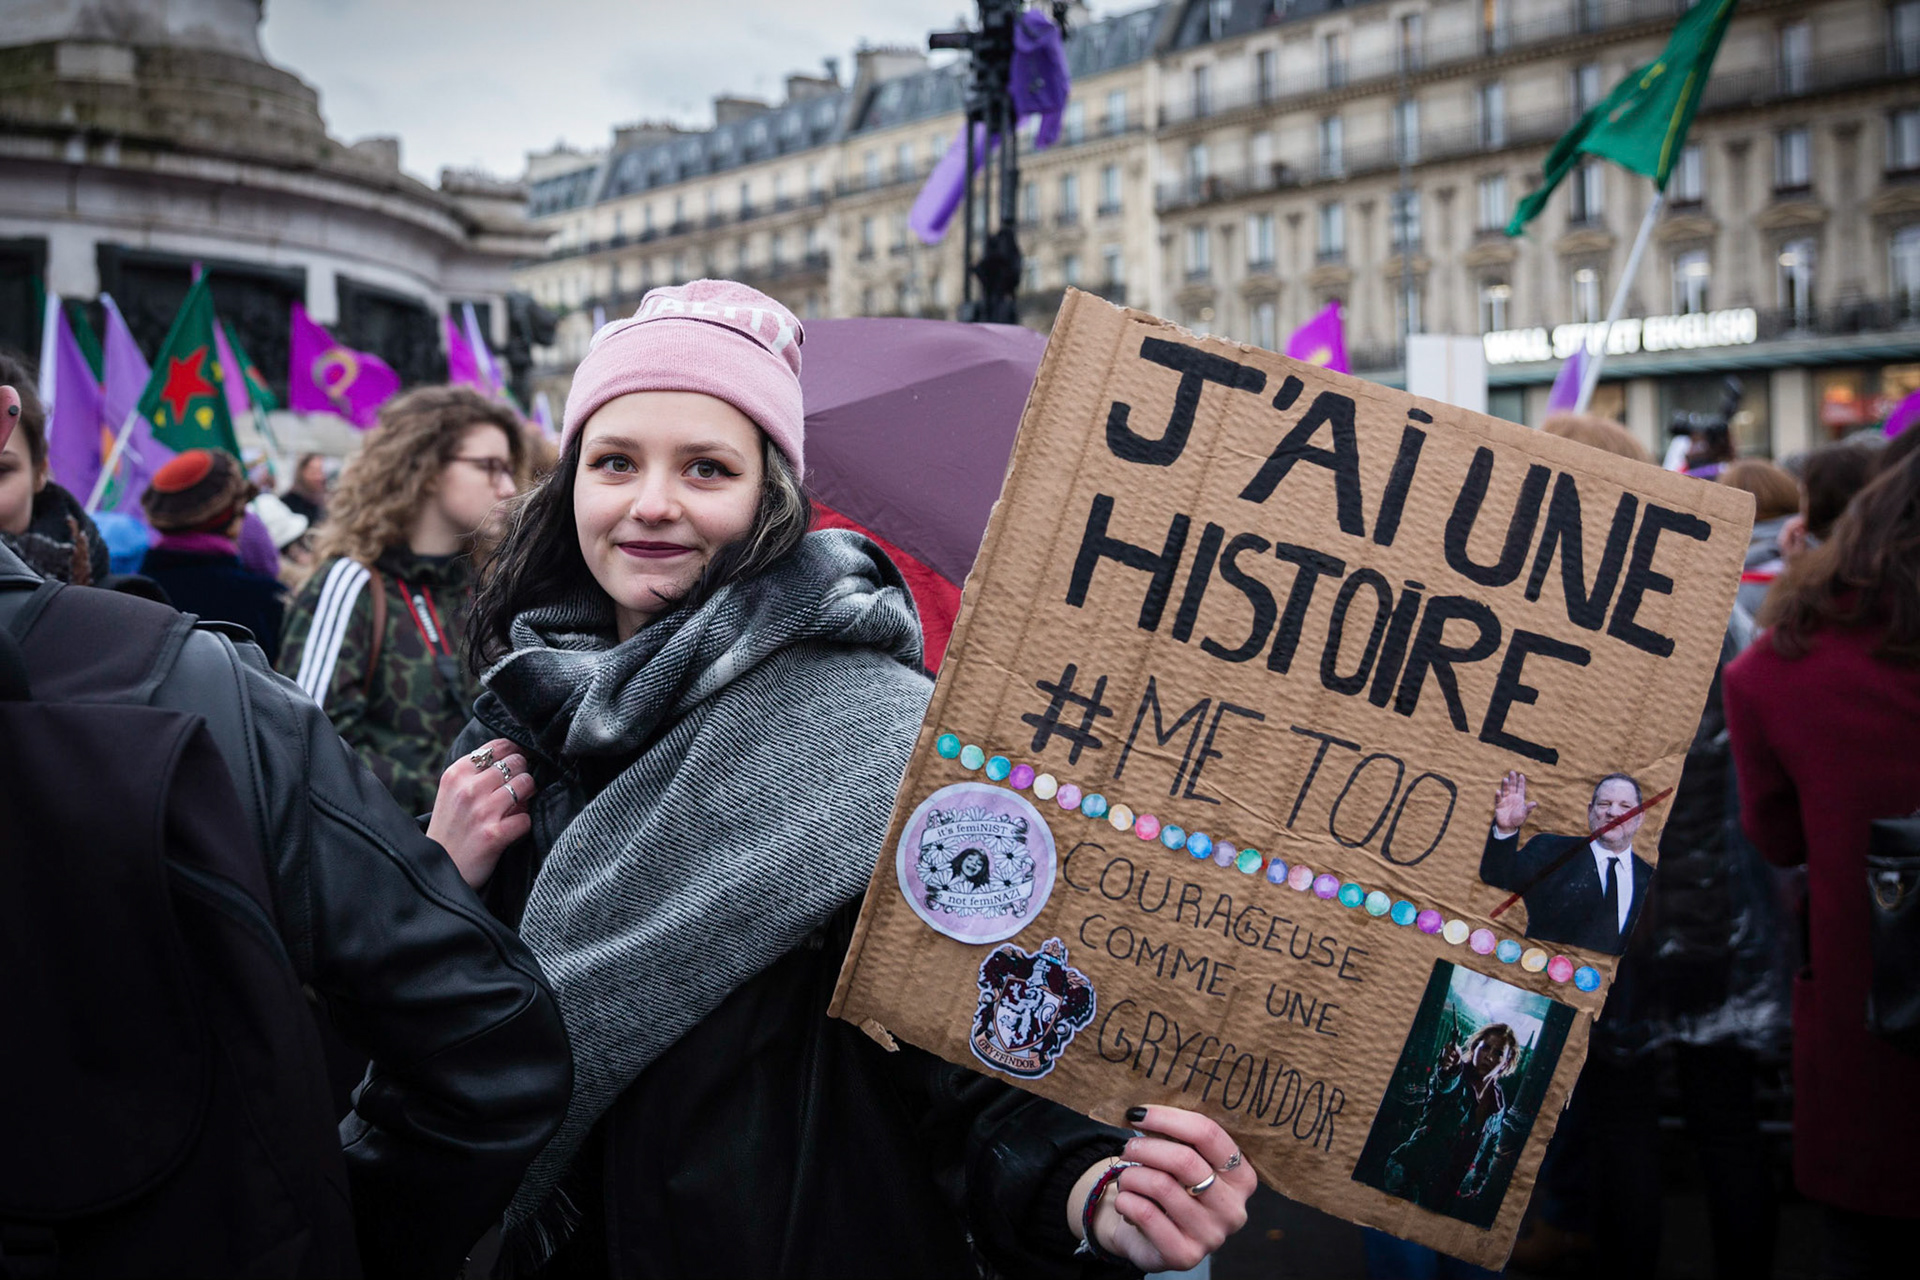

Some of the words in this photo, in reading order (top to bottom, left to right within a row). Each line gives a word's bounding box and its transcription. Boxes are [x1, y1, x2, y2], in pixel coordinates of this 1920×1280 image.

[1444, 446, 1712, 658] UNE
[937, 825, 954, 837] it's
[956, 823, 1008, 835] femiNIST
[1287, 725, 1457, 866] TOO
[948, 895, 967, 906] not
[970, 888, 1021, 906] femiNAZI
[1062, 842, 1369, 982] COURAGEUSE
[1079, 914, 1236, 996] COMME
[1266, 984, 1340, 1037] UNE
[978, 1038, 1036, 1069] GRYFFINDOR
